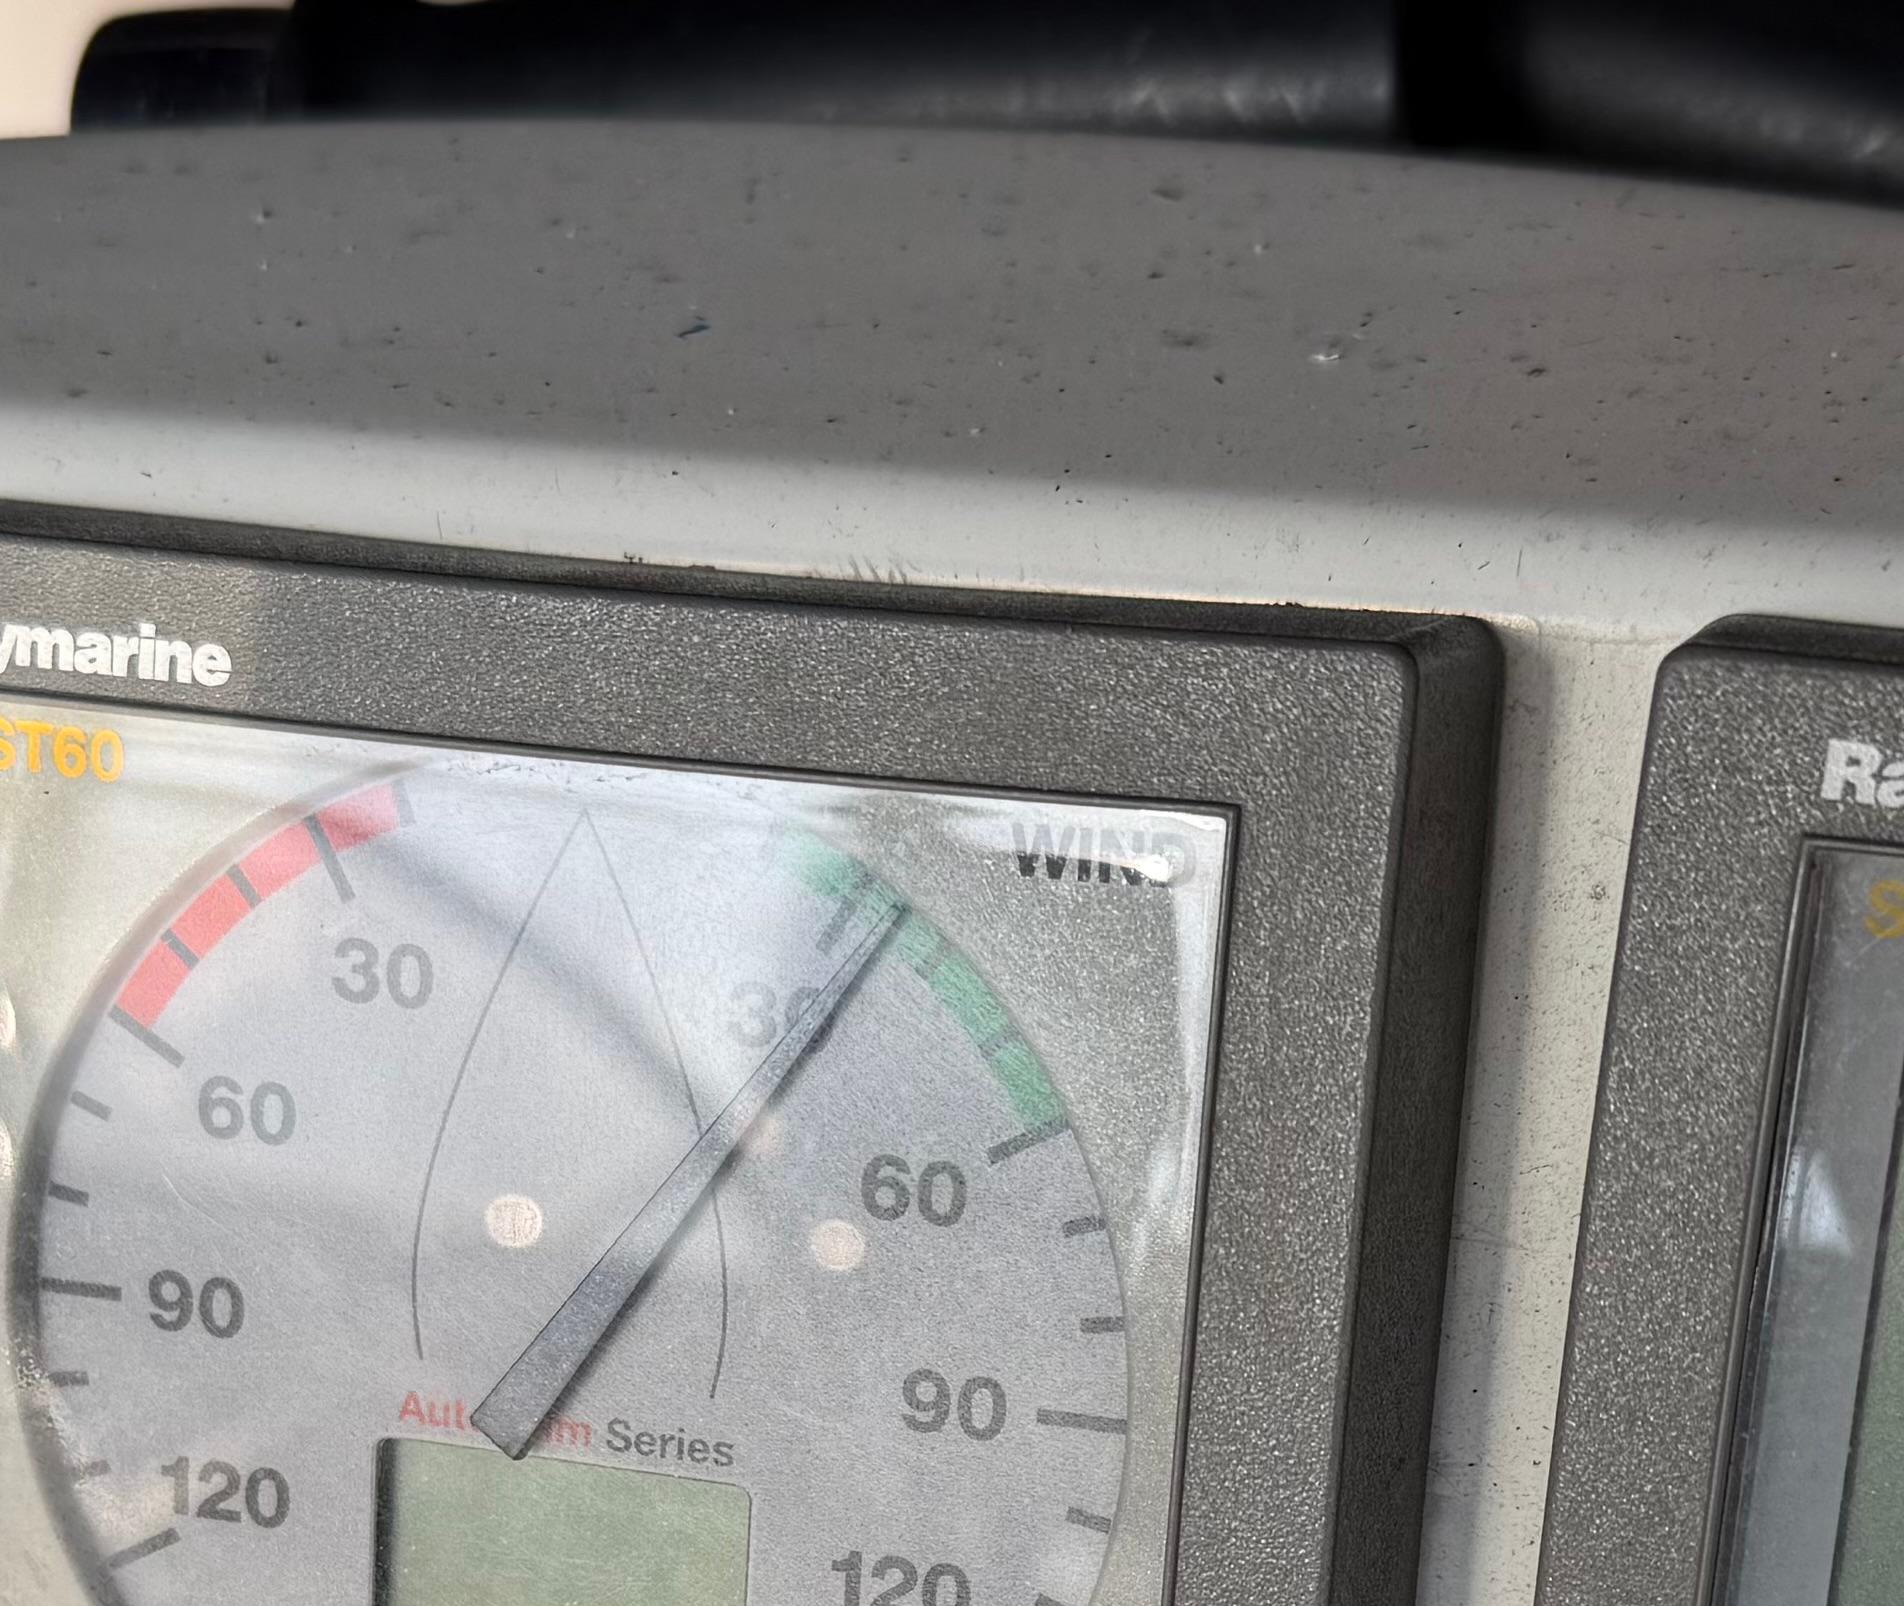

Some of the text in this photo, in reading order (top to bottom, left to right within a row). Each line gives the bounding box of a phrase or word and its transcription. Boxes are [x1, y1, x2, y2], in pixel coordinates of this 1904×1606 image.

[1011, 821, 1197, 889] WIND
[331, 936, 434, 1010] 30
[198, 1075, 297, 1147] 60
[860, 1153, 968, 1227] 60
[148, 1269, 245, 1339] 90
[399, 1390, 735, 1467] Autm Series
[901, 1368, 1007, 1441] 90
[161, 1455, 291, 1529] 120
